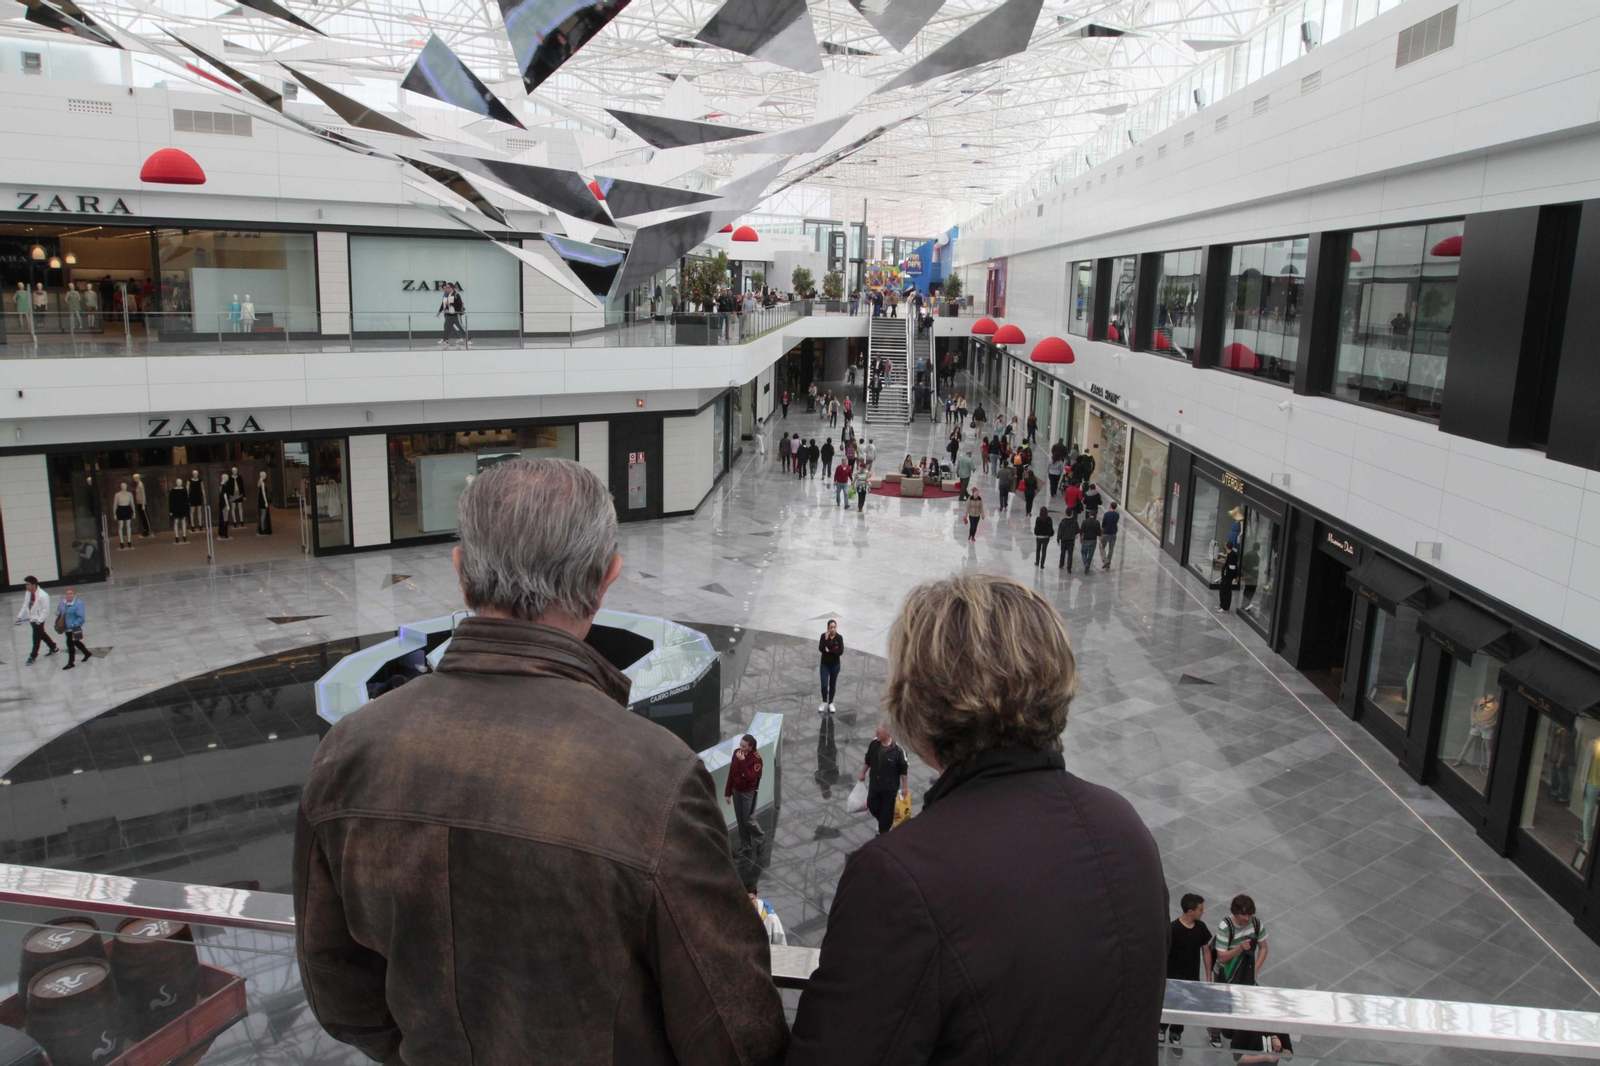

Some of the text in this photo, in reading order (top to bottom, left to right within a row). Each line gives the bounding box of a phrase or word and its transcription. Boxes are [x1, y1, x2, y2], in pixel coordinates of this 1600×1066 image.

[17, 192, 134, 215] ZARA
[402, 279, 465, 292] ZARA
[148, 414, 265, 437] ZARA
[650, 684, 691, 703] CAJERO PARKING
